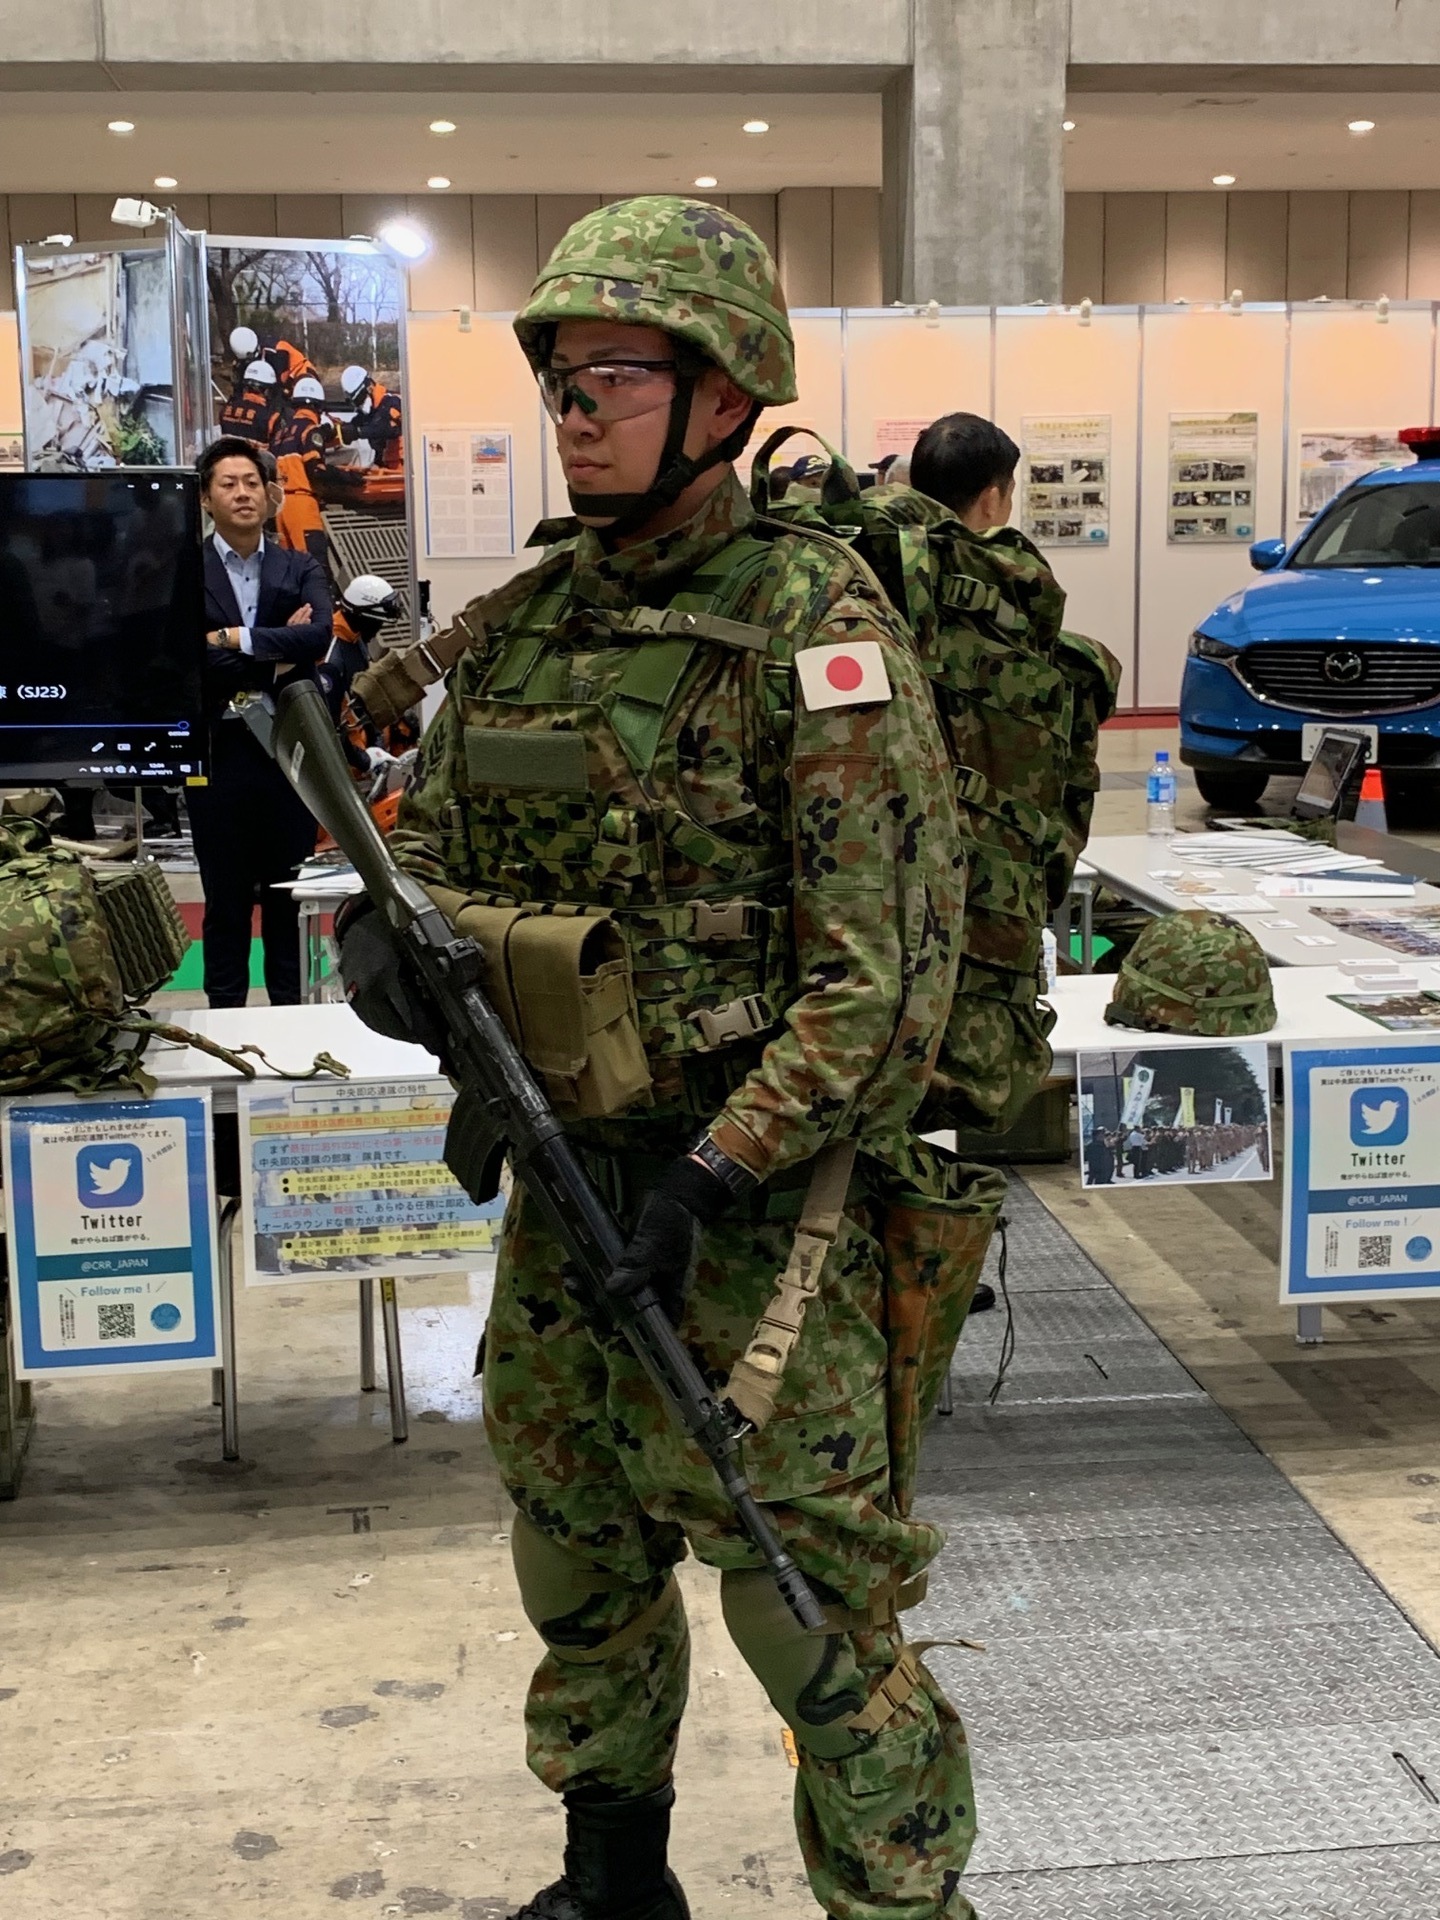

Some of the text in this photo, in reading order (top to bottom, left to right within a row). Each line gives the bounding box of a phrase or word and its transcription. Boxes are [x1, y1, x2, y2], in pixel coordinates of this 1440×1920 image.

[336, 1083, 428, 1099] 中央即応連隊の特性
[1350, 1152, 1406, 1167] Twitter
[1347, 1193, 1408, 1207] @CRR_JAPAN
[80, 1213, 144, 1231] Twitter
[1345, 1217, 1382, 1230] Follow
[1384, 1218, 1400, 1228] me
[80, 1257, 149, 1273] @CRR_JAPAN
[80, 1284, 121, 1298] Follow
[123, 1286, 143, 1295] me
